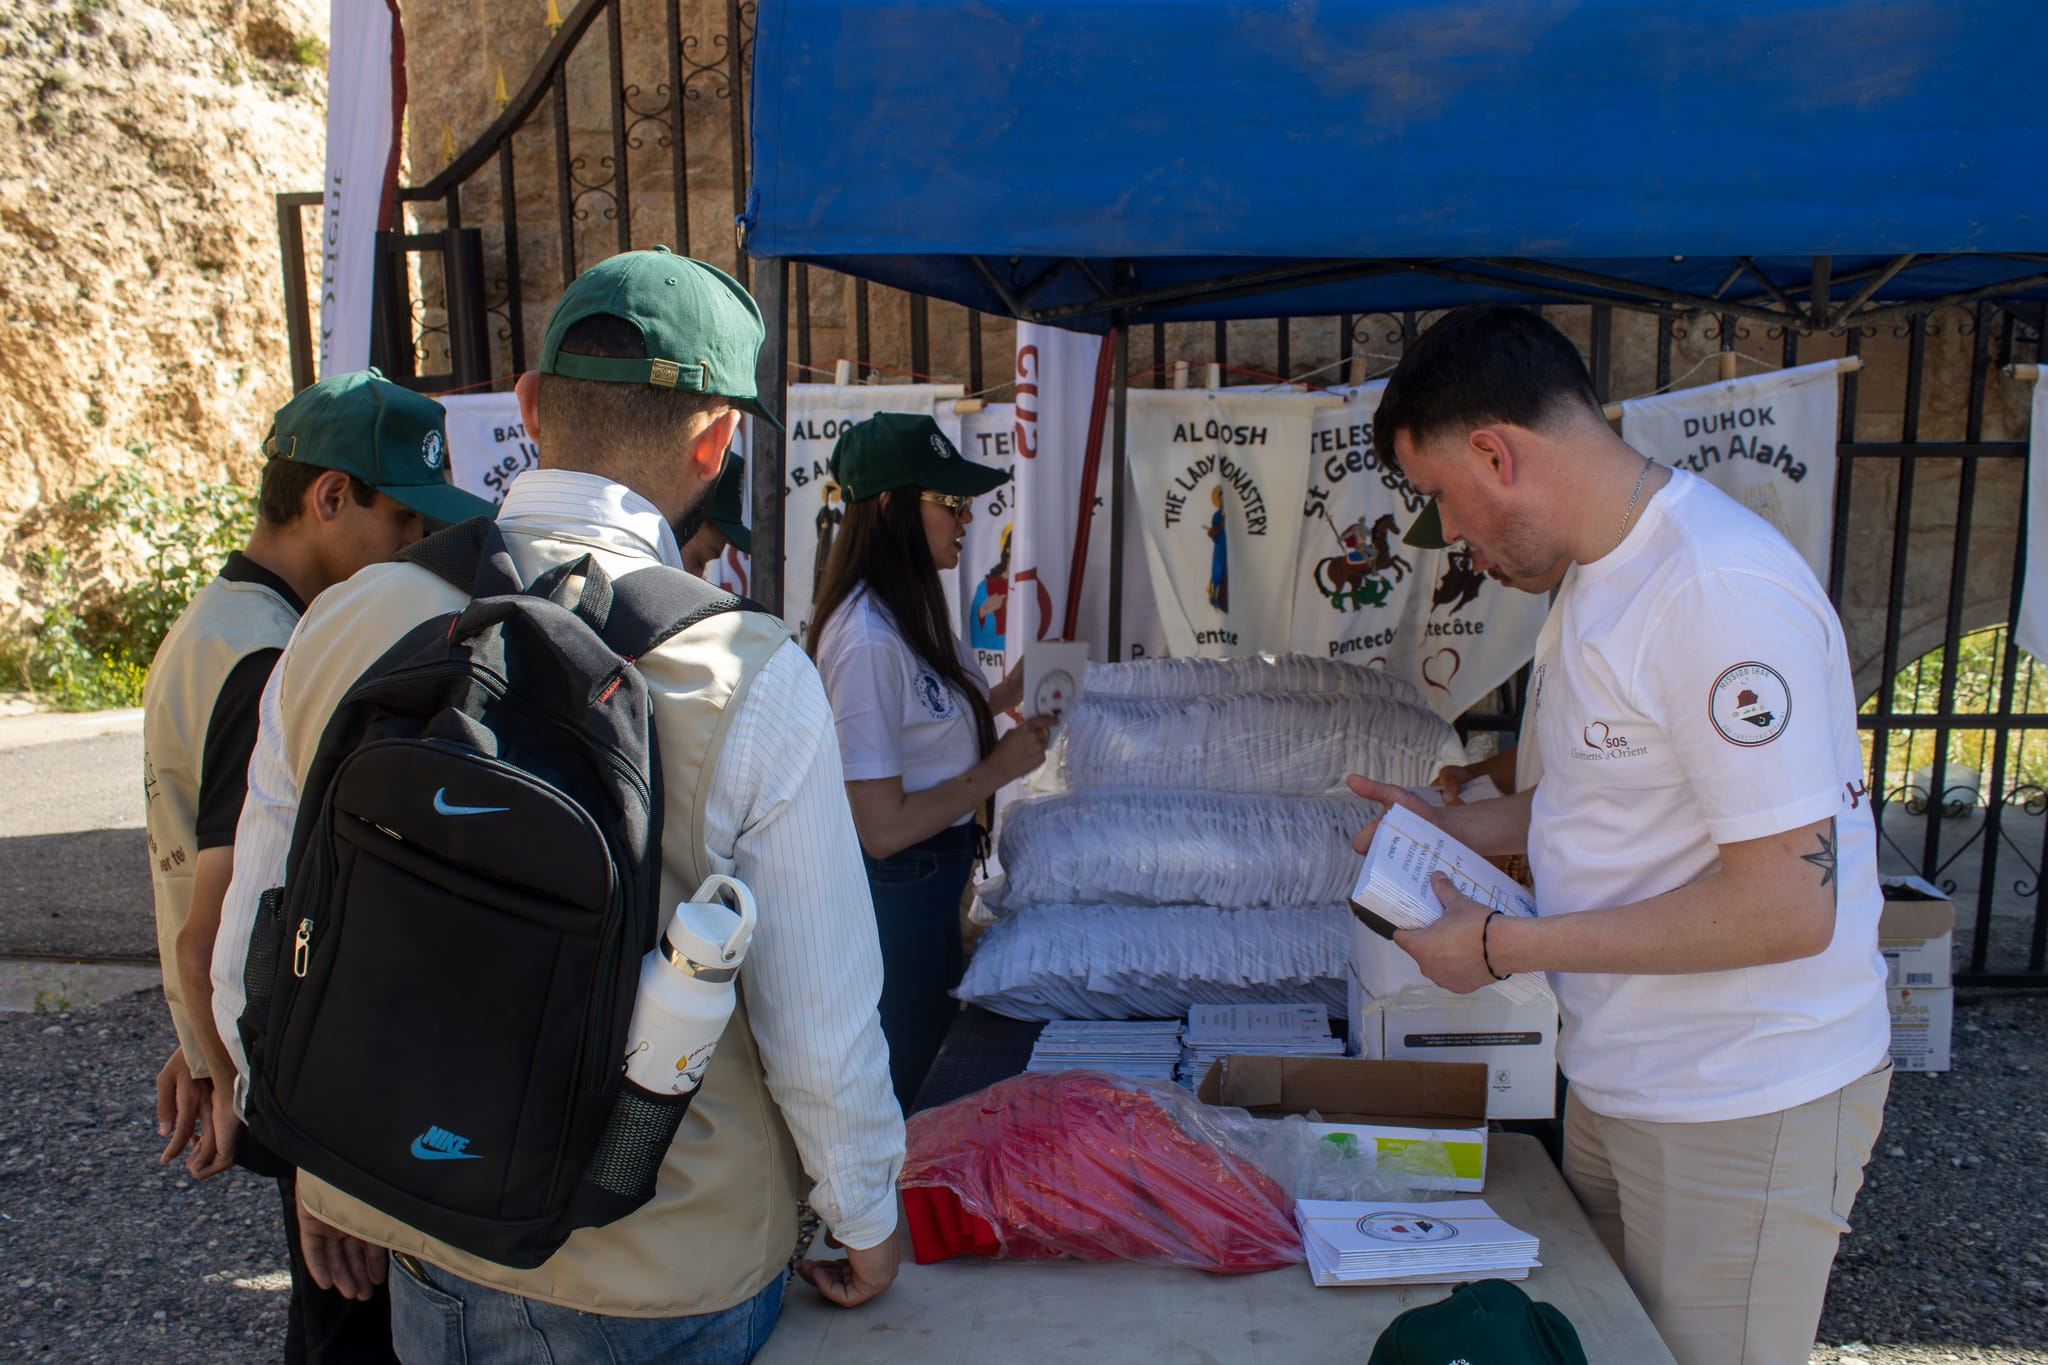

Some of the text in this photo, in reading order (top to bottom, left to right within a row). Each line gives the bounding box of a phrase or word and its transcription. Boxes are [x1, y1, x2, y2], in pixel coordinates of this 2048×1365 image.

[494, 423, 526, 442] BAT
[793, 420, 854, 440] ALQO
[1173, 420, 1267, 446] ALQOSH
[1684, 406, 1776, 438] DUHOK
[1311, 422, 1374, 455] TELES
[483, 455, 520, 491] Ste
[1175, 454, 1216, 491] LADY
[1728, 434, 1808, 483] Alaha
[1165, 490, 1186, 529] THE
[1304, 485, 1330, 519] St
[1329, 627, 1398, 658] Pentecô
[1425, 618, 1485, 637] tecôte
[1605, 736, 1628, 748] SOS
[1605, 745, 1648, 760] d'Orient
[422, 1125, 471, 1153] NIKE
